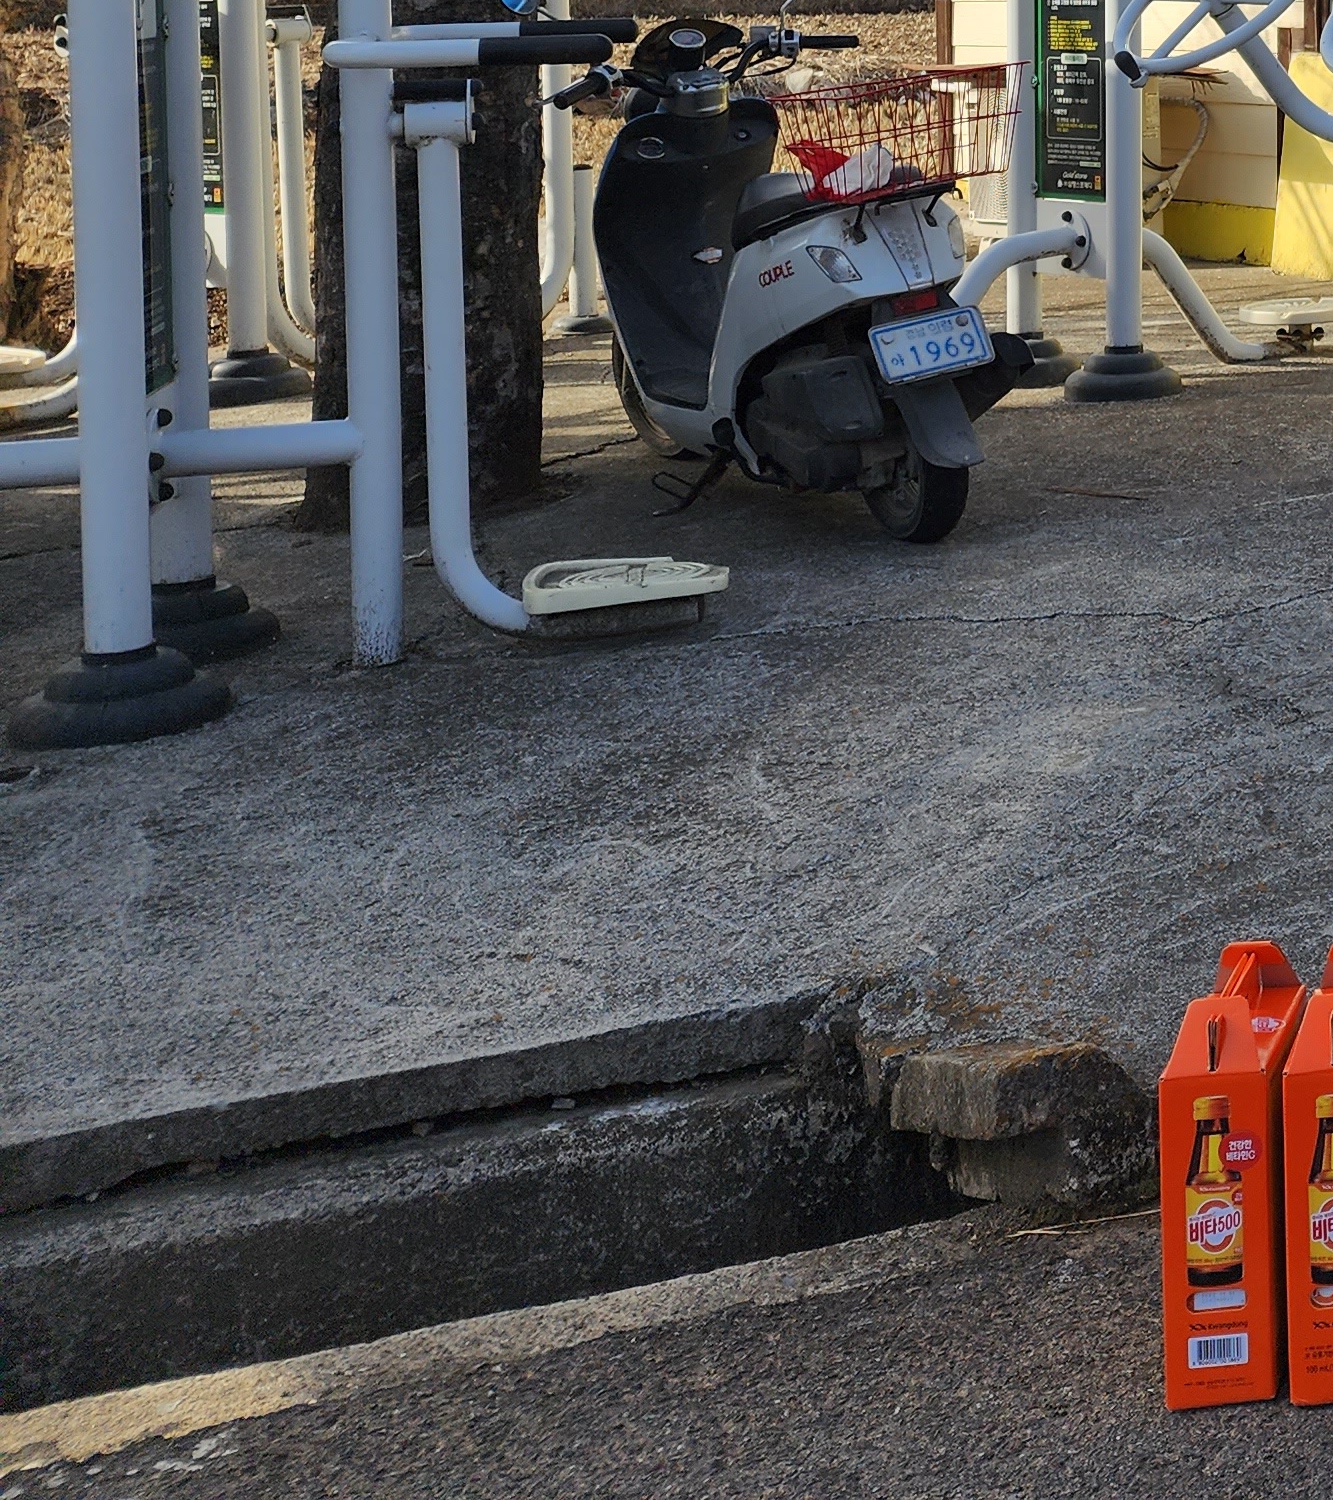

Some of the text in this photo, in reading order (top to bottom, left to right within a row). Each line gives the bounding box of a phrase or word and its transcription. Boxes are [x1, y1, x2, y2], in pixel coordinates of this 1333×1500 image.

[758, 260, 795, 288] COUPLE
[910, 332, 975, 366] 1969
[1225, 1150, 1256, 1162] 비타민C
[1228, 1139, 1253, 1150] 건강한
[1189, 1211, 1241, 1243] 비타500
